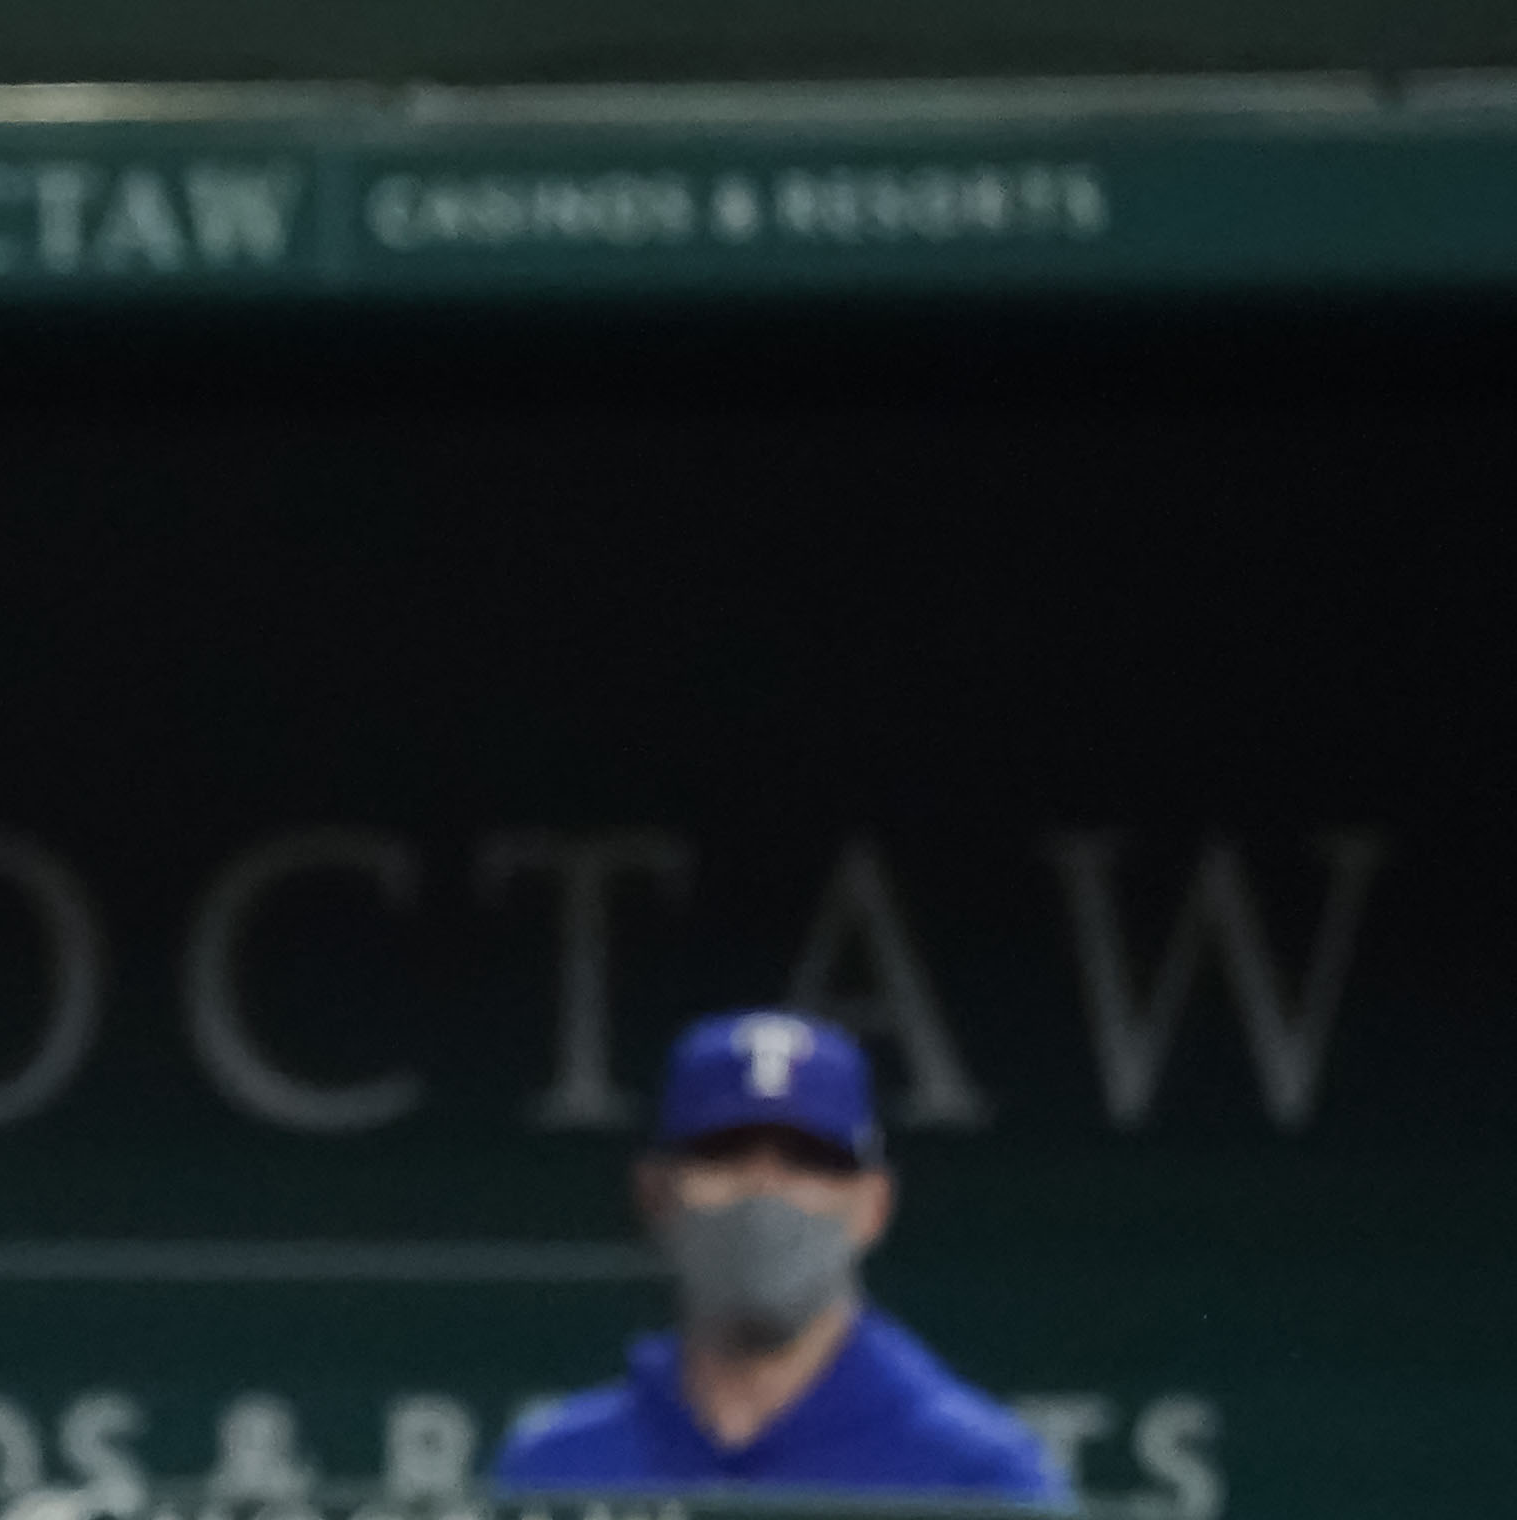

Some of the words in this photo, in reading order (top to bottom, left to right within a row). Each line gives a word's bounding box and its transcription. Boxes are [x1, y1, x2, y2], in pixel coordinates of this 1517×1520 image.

[372, 172, 695, 247] CASINOS
[779, 168, 1107, 245] RESORTS
[731, 1010, 815, 1100] T
